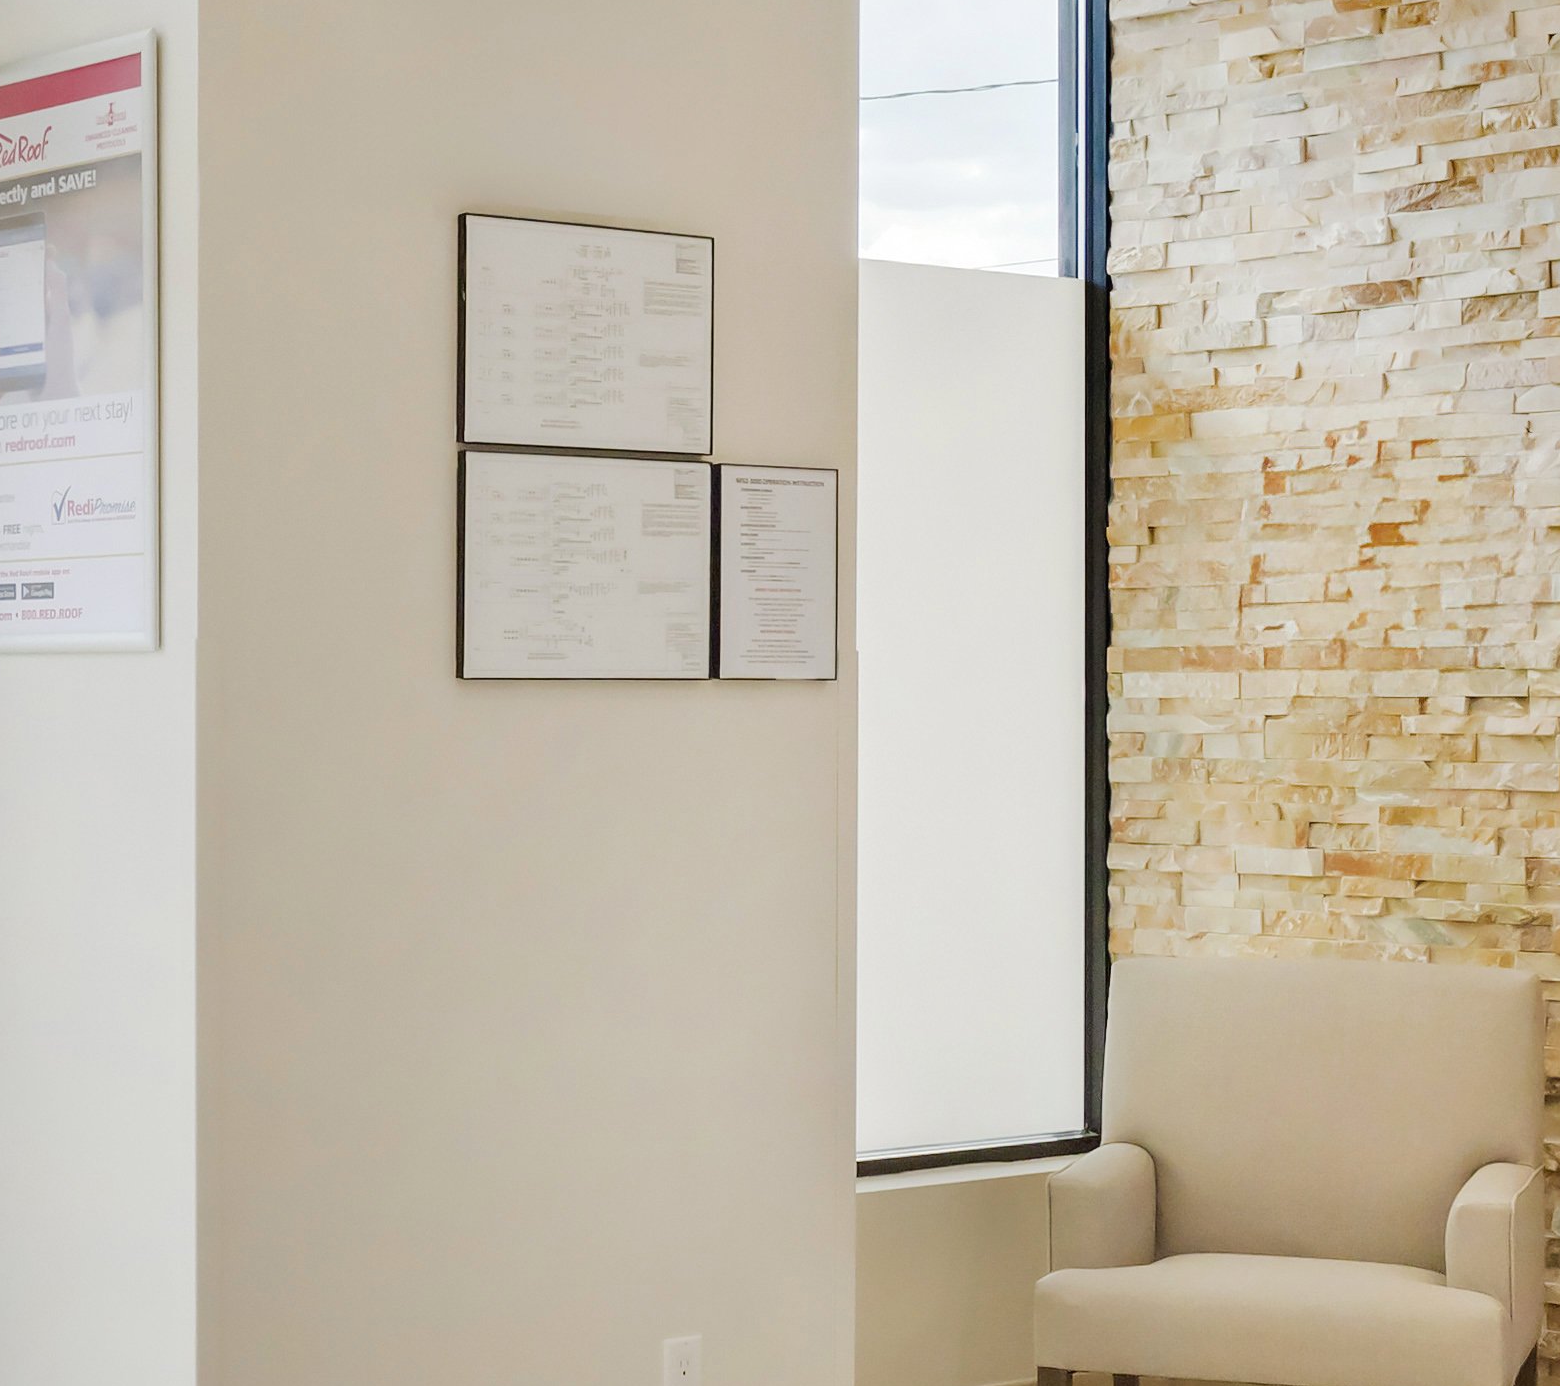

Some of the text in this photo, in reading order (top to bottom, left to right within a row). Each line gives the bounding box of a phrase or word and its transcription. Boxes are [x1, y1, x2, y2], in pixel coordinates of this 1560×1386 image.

[18, 126, 53, 162] Roof
[31, 178, 55, 199] and
[58, 169, 97, 193] SAVE!
[22, 414, 38, 429] on
[41, 409, 70, 432] your
[74, 404, 101, 422] next
[105, 397, 133, 424] stay!
[5, 434, 76, 453] redroof.com
[67, 497, 136, 517] RediPromise
[2, 524, 21, 535] FREE
